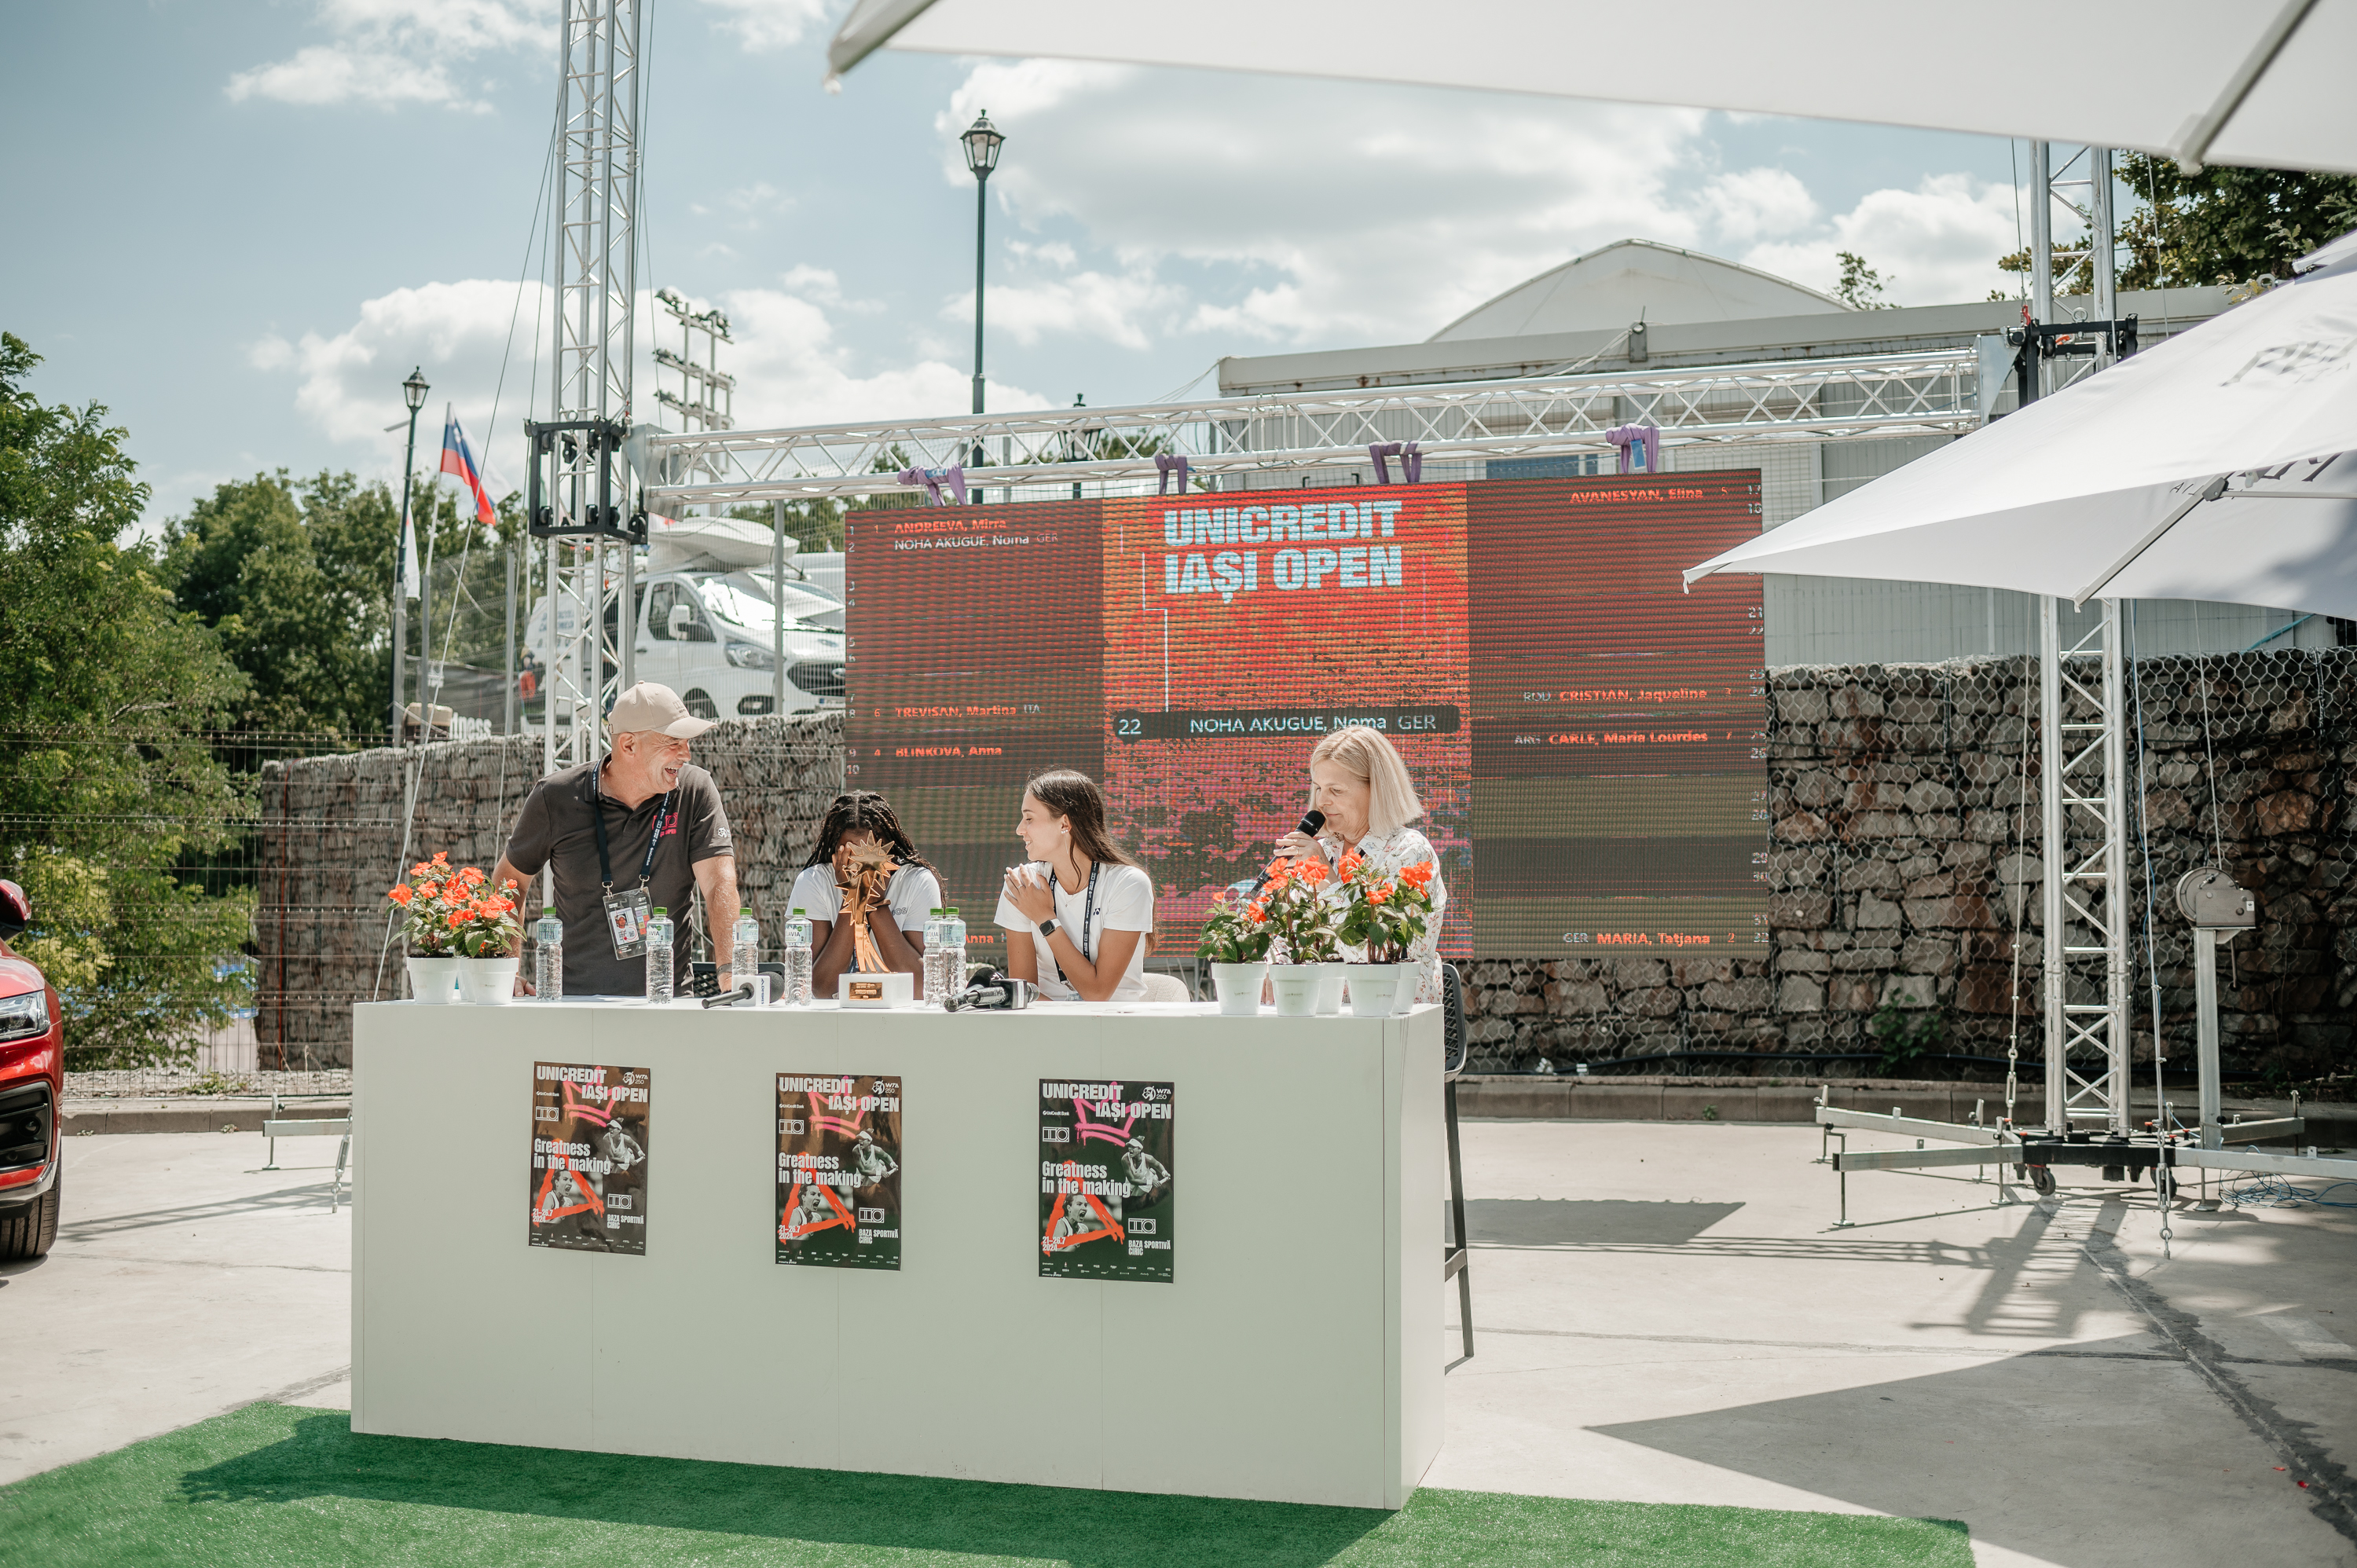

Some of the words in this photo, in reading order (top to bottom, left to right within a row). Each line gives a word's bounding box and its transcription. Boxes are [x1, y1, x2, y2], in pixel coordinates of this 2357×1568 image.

[894, 519, 967, 533] ANDREEVA,
[972, 518, 1006, 529] Mirra
[1164, 500, 1402, 546] UNICREDIT
[894, 538, 933, 551] NOHA
[935, 536, 989, 549] AKUGUE,
[992, 535, 1029, 546] Noma
[1036, 533, 1058, 543] GER
[1165, 551, 1258, 604] IAȘI
[1273, 545, 1402, 591] OPEN
[1560, 689, 1633, 702] CRISTIAN,
[1637, 687, 1707, 703] Jaqueline
[874, 708, 881, 718] 6
[895, 705, 962, 718] TREVISAN,
[966, 705, 1017, 716] Martina
[1023, 704, 1042, 714] ITA
[1118, 719, 1142, 735] 22
[1190, 718, 1245, 734] NOHA
[1248, 716, 1328, 734] AKUGUE,
[1397, 714, 1437, 730] GER
[1548, 734, 1599, 746] CARLE,
[1604, 731, 1646, 743] Maria
[1650, 731, 1708, 743] Lourdes
[895, 746, 965, 758] BLINKOVA,
[968, 746, 1003, 756] Anna
[1596, 932, 1652, 946] MARIA,
[1657, 932, 1710, 947] Tatjana
[1728, 932, 1735, 943] 2
[537, 1065, 607, 1084] UNICREDIT
[779, 1076, 855, 1094] UNICREDIT
[1043, 1083, 1124, 1101] UNICREDIT
[581, 1084, 608, 1105] IAȘI
[611, 1086, 648, 1103] OPEN
[828, 1095, 857, 1116] IAȘI
[860, 1096, 900, 1112] OPEN
[1095, 1101, 1126, 1123] IAȘI
[1130, 1103, 1171, 1119] OPEN
[533, 1138, 591, 1156] Greatness
[533, 1152, 544, 1169] in
[547, 1154, 566, 1171] the
[568, 1157, 611, 1175] making
[779, 1152, 839, 1170] Greatness
[1042, 1160, 1108, 1179] Greatness
[779, 1167, 790, 1184] in
[793, 1169, 812, 1185] the
[816, 1170, 861, 1189] making
[1042, 1177, 1054, 1193] in
[1058, 1178, 1079, 1194] the
[1082, 1179, 1131, 1198] making
[607, 1214, 620, 1222] BAZA
[859, 1229, 873, 1237] BAZA
[859, 1236, 873, 1244] CIRIC
[1128, 1240, 1144, 1248] BAZA
[1128, 1247, 1144, 1256] CIRIC
